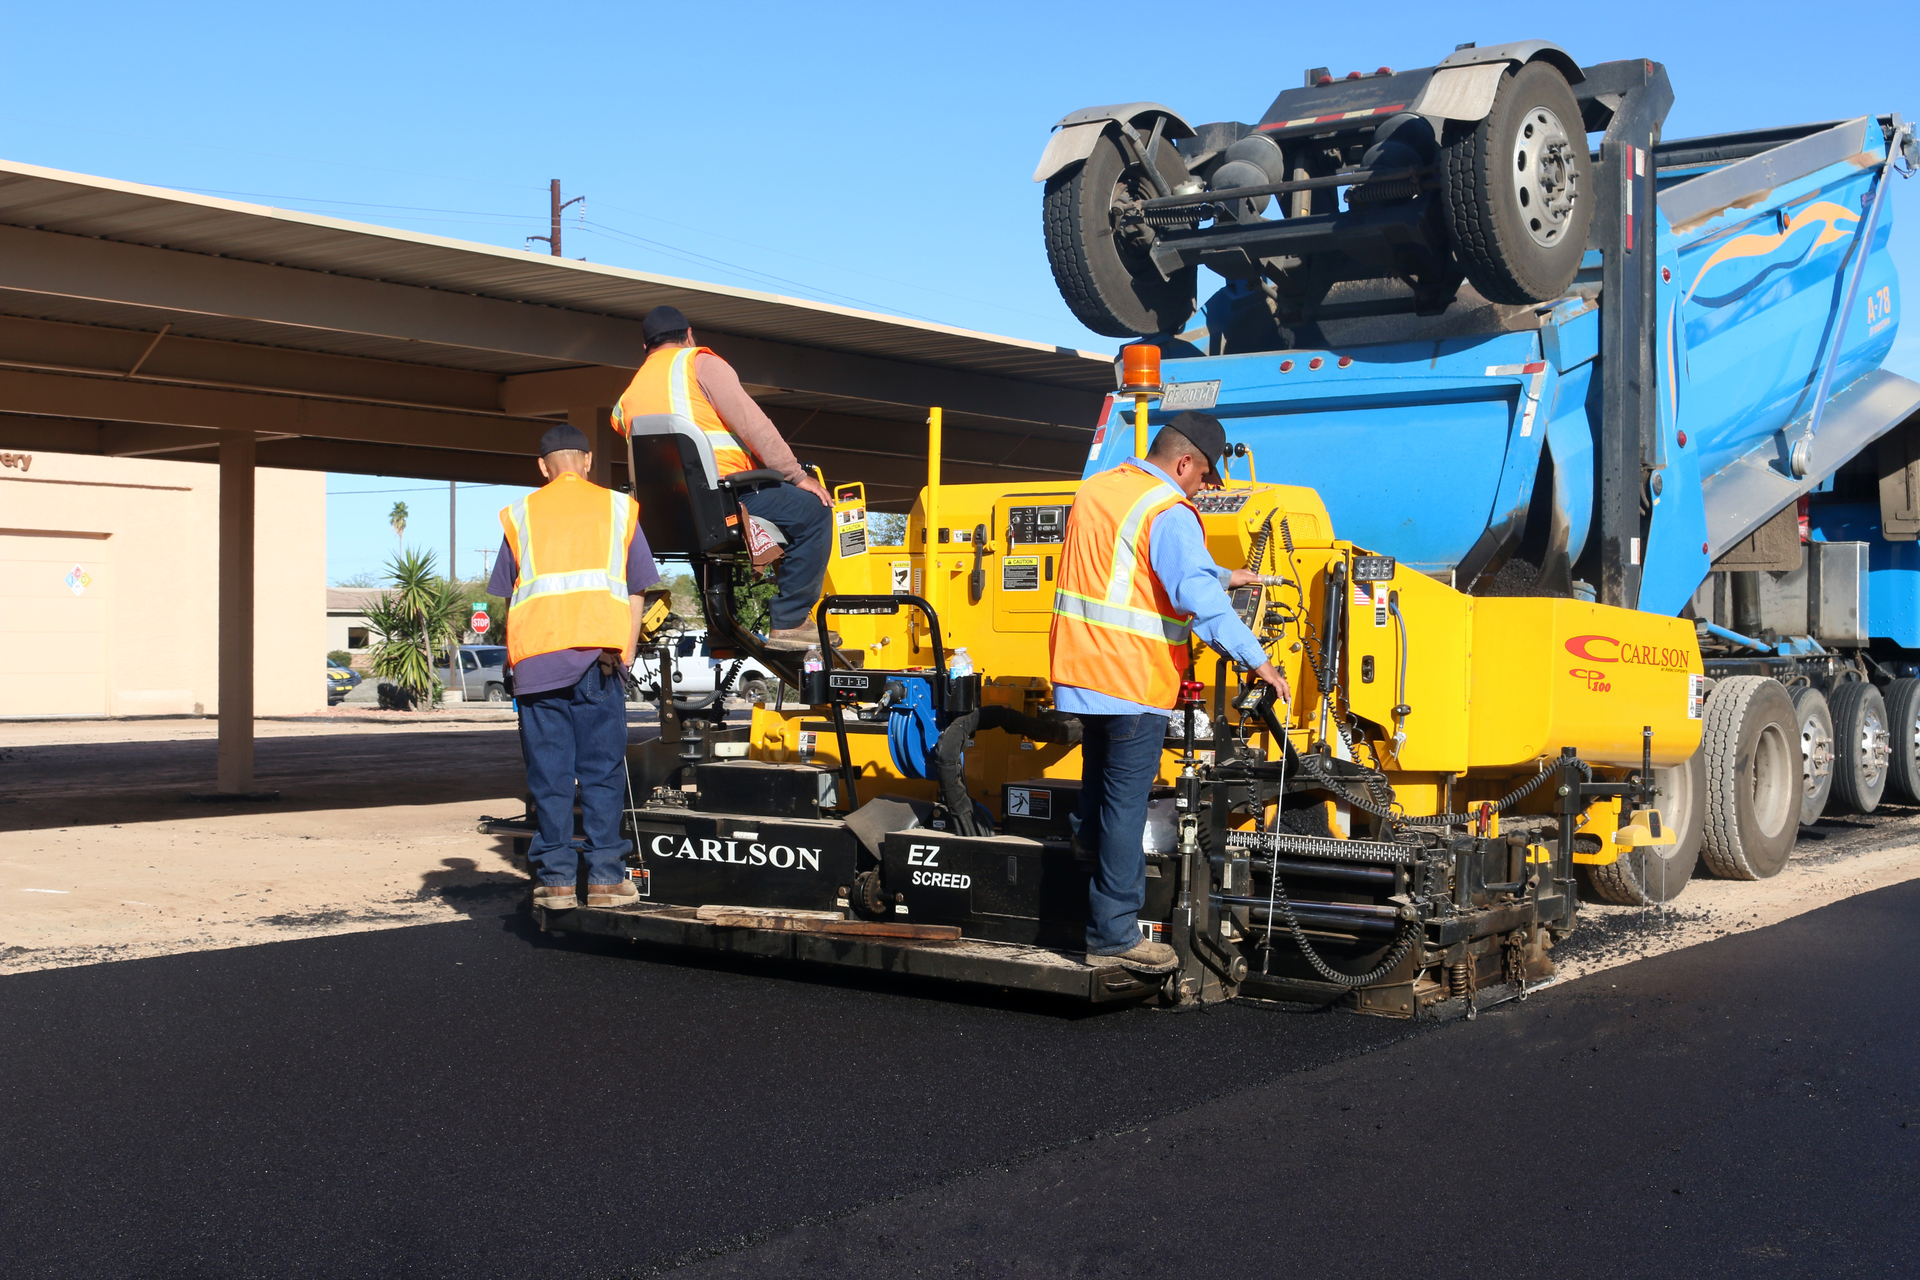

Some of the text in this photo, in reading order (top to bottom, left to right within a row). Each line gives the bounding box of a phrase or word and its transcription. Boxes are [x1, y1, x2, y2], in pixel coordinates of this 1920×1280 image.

[1867, 285, 1891, 325] A-78
[0, 452, 33, 472] ery
[473, 618, 489, 627] STOP
[1620, 643, 1690, 668] CARLSON
[1591, 681, 1612, 692] 100
[651, 834, 823, 872] CARLSON
[907, 843, 941, 867] EZ
[911, 870, 972, 890] SCREED
